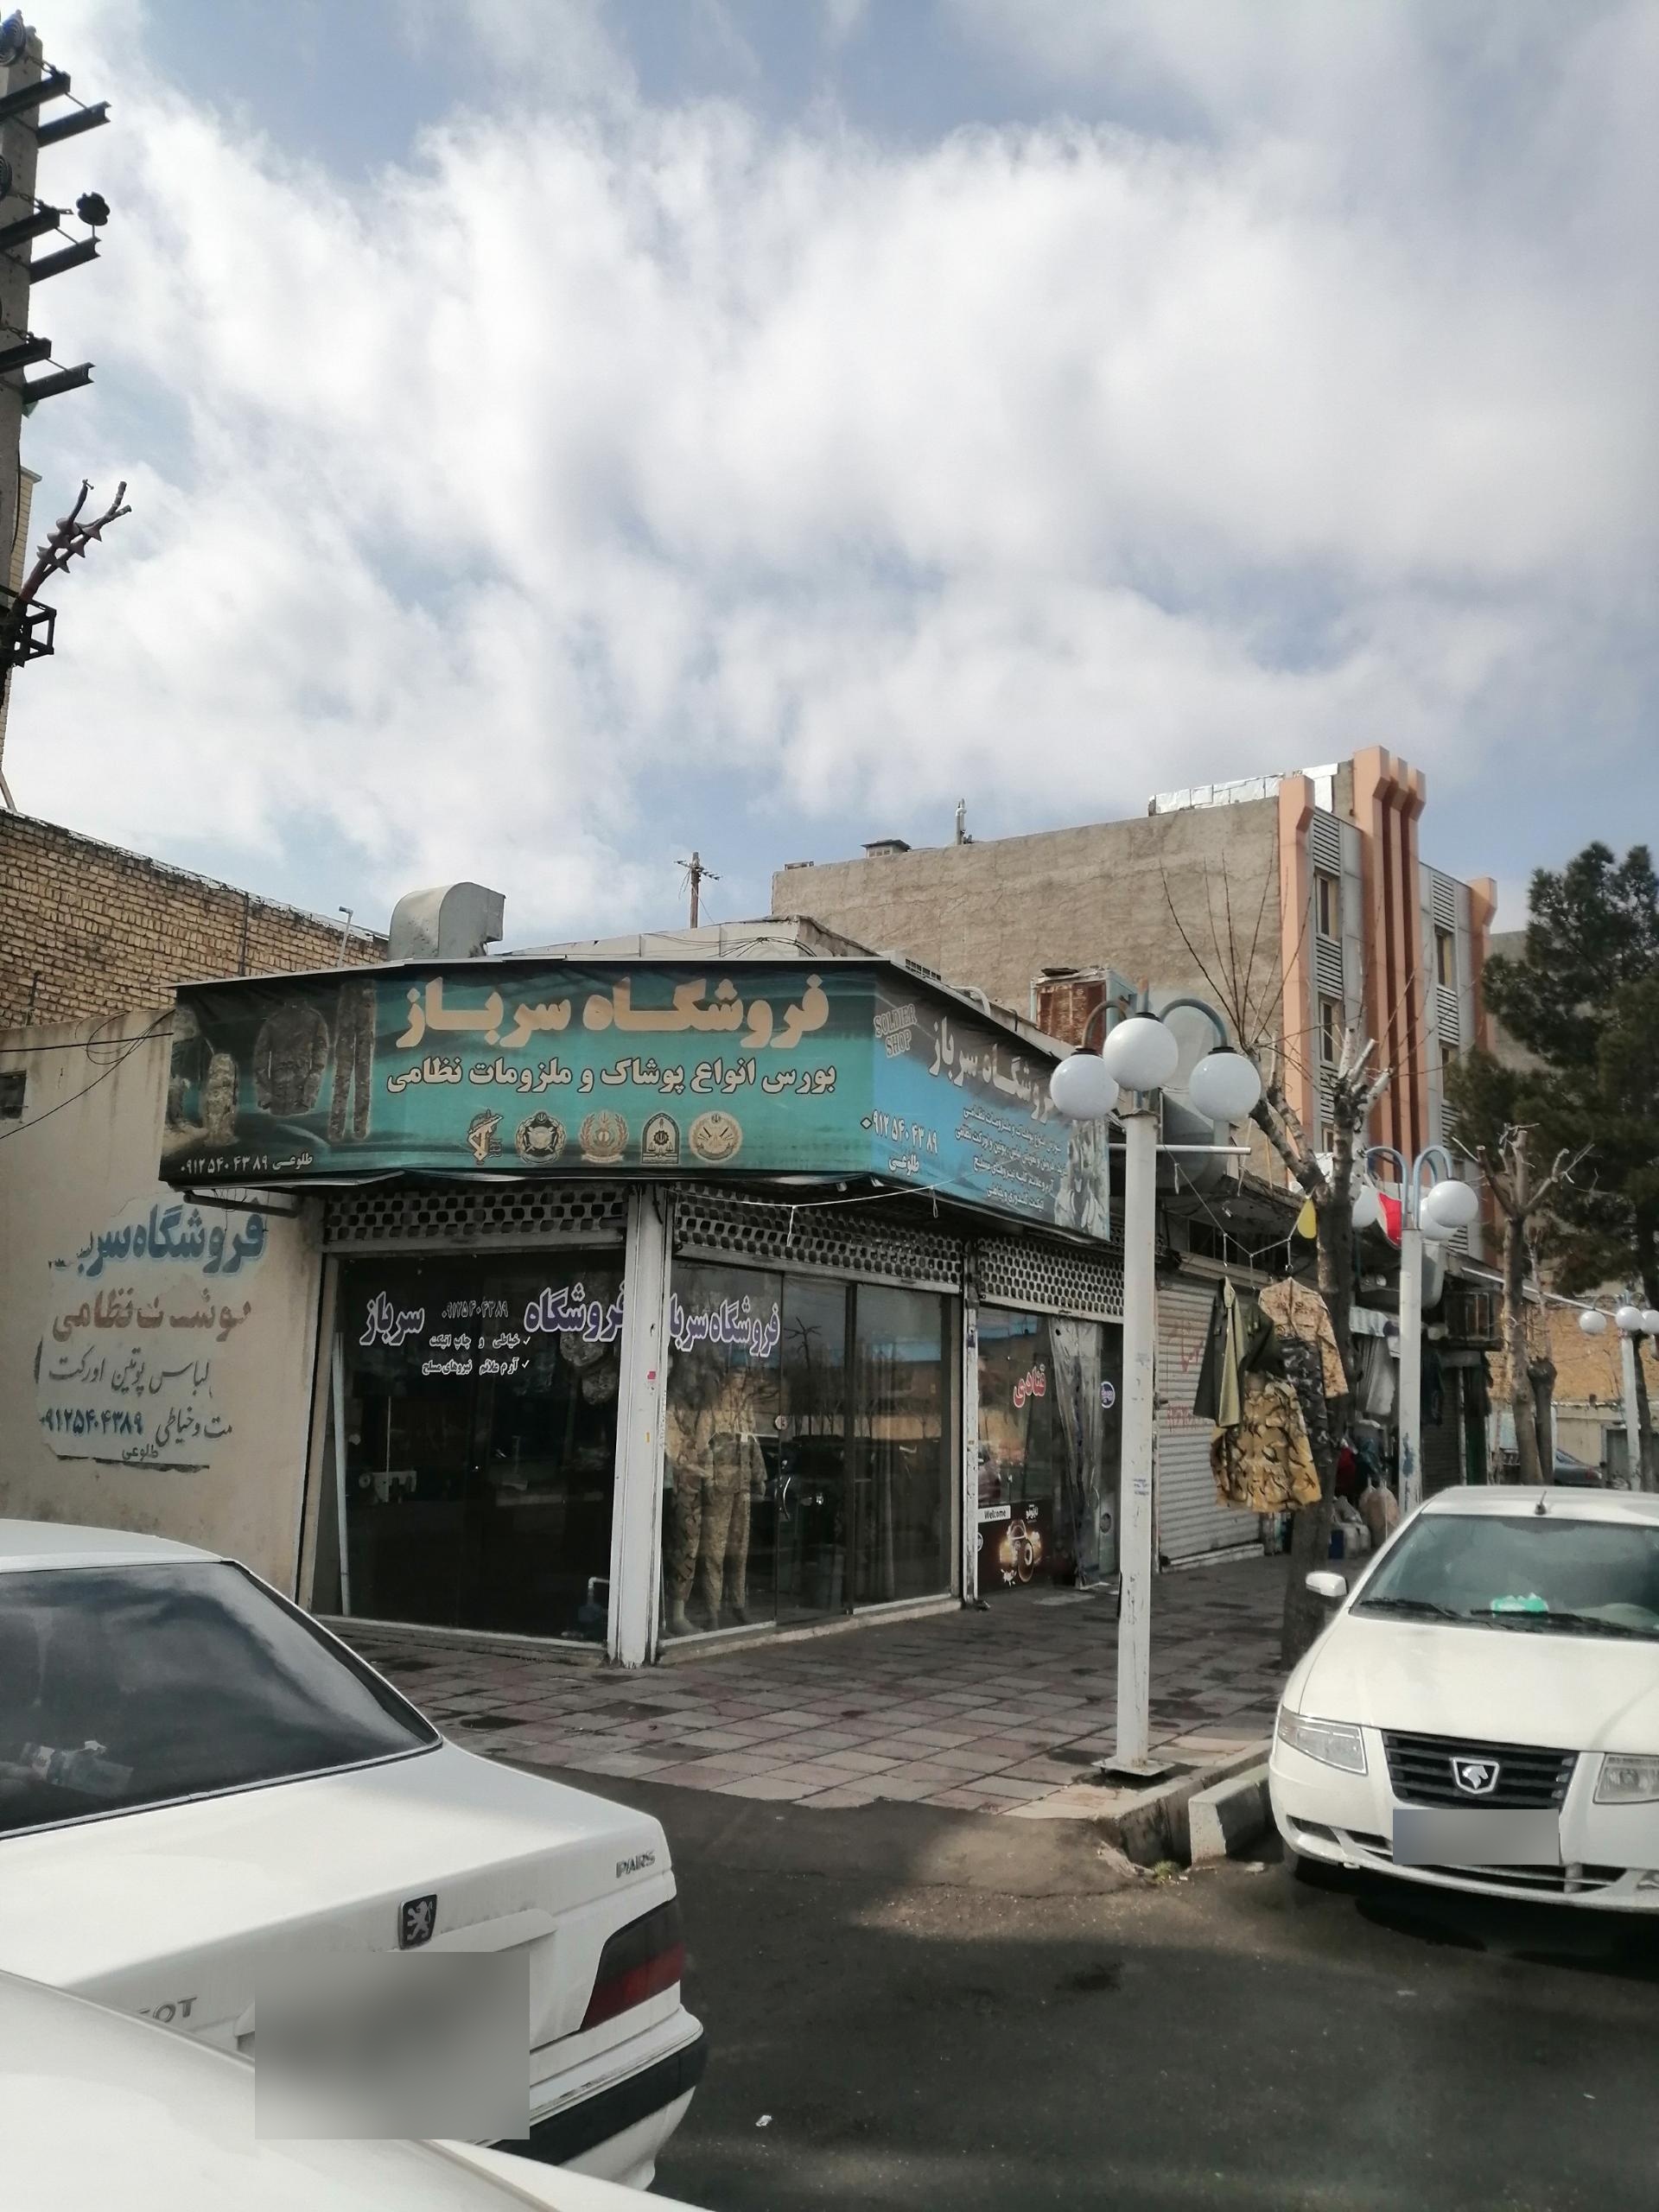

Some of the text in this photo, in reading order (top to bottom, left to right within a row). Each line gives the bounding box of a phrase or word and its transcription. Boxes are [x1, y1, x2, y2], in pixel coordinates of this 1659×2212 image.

[396, 974, 829, 1048] فروشگاه سرباز
[873, 1003, 918, 1038] SOLDIER
[886, 1028, 912, 1058] SHOP
[929, 1016, 978, 1087] سرباز
[386, 1056, 836, 1096] بورس انواع پوشاک و ملزومات نظامی
[272, 1152, 313, 1171] طلوعی
[131, 1198, 265, 1275] فروشگاه
[53, 1287, 135, 1342] نظامی
[359, 1291, 425, 1346] سرباز
[670, 1292, 780, 1357] فروشگاه سربا
[454, 1333, 472, 1351] چاپ
[478, 1336, 485, 1350] و
[492, 1332, 520, 1349] خیاطی
[49, 1345, 210, 1397] لباس پوتین اورکت
[156, 1406, 193, 1447] خیاطی
[984, 1509, 1007, 1520] Welcome
[615, 1850, 656, 1878] PARS
